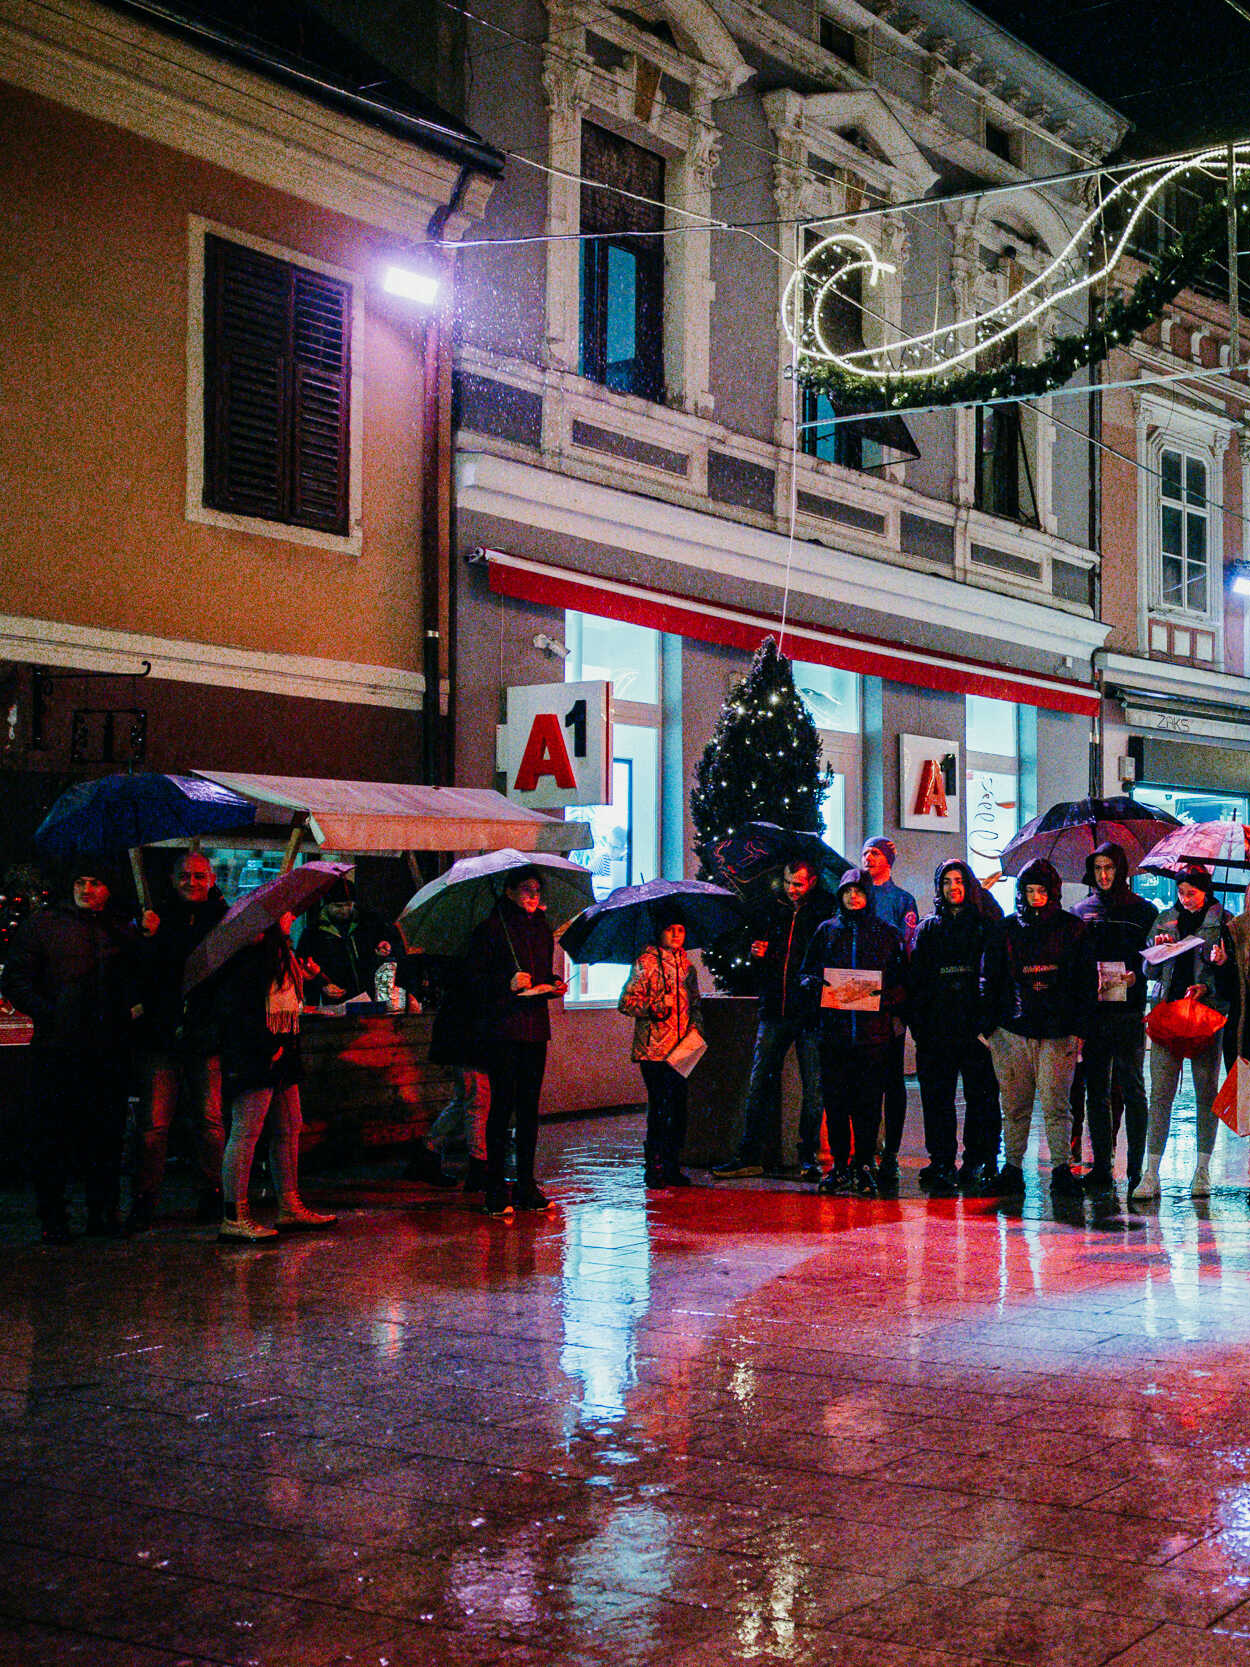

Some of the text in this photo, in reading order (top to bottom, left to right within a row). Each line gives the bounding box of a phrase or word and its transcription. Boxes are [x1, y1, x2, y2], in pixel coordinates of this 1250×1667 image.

[513, 699, 587, 790] A1
[1158, 714, 1190, 733] ZAKS
[914, 753, 957, 817] A1
